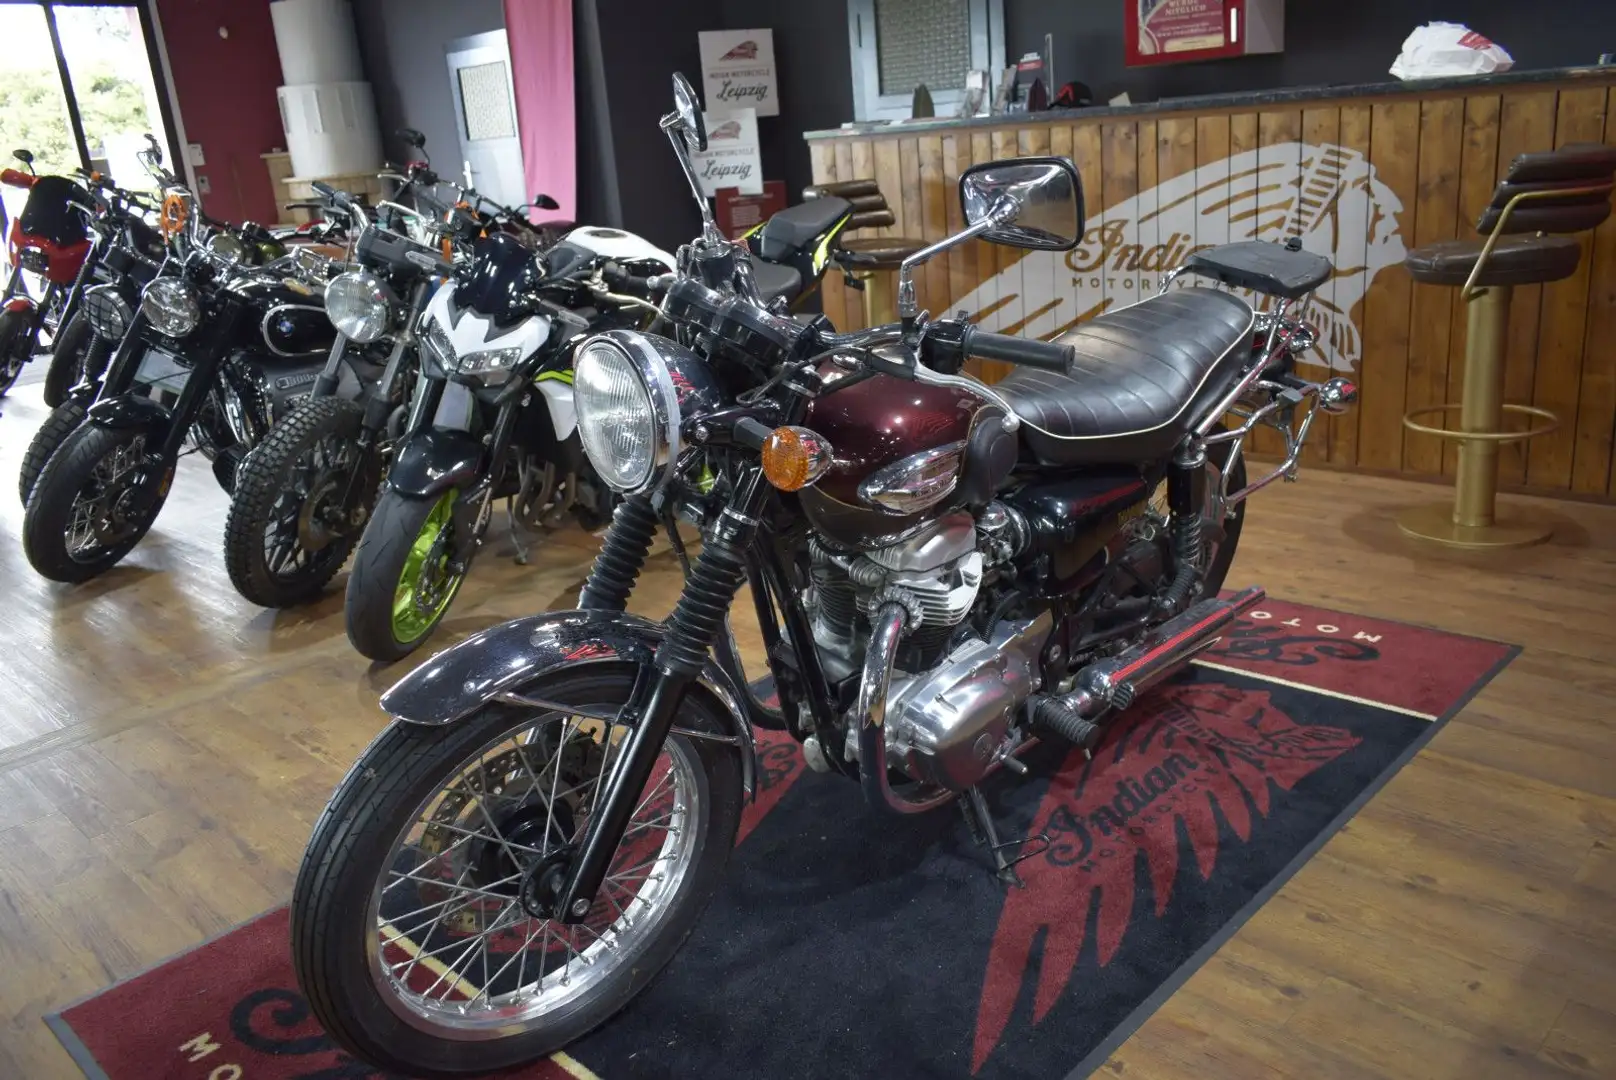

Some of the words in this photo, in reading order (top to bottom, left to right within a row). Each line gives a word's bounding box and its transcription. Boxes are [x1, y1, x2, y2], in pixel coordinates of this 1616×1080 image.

[716, 80, 768, 102] Leipzig
[701, 159, 752, 180] Leipzig
[1045, 753, 1198, 867] Indian
